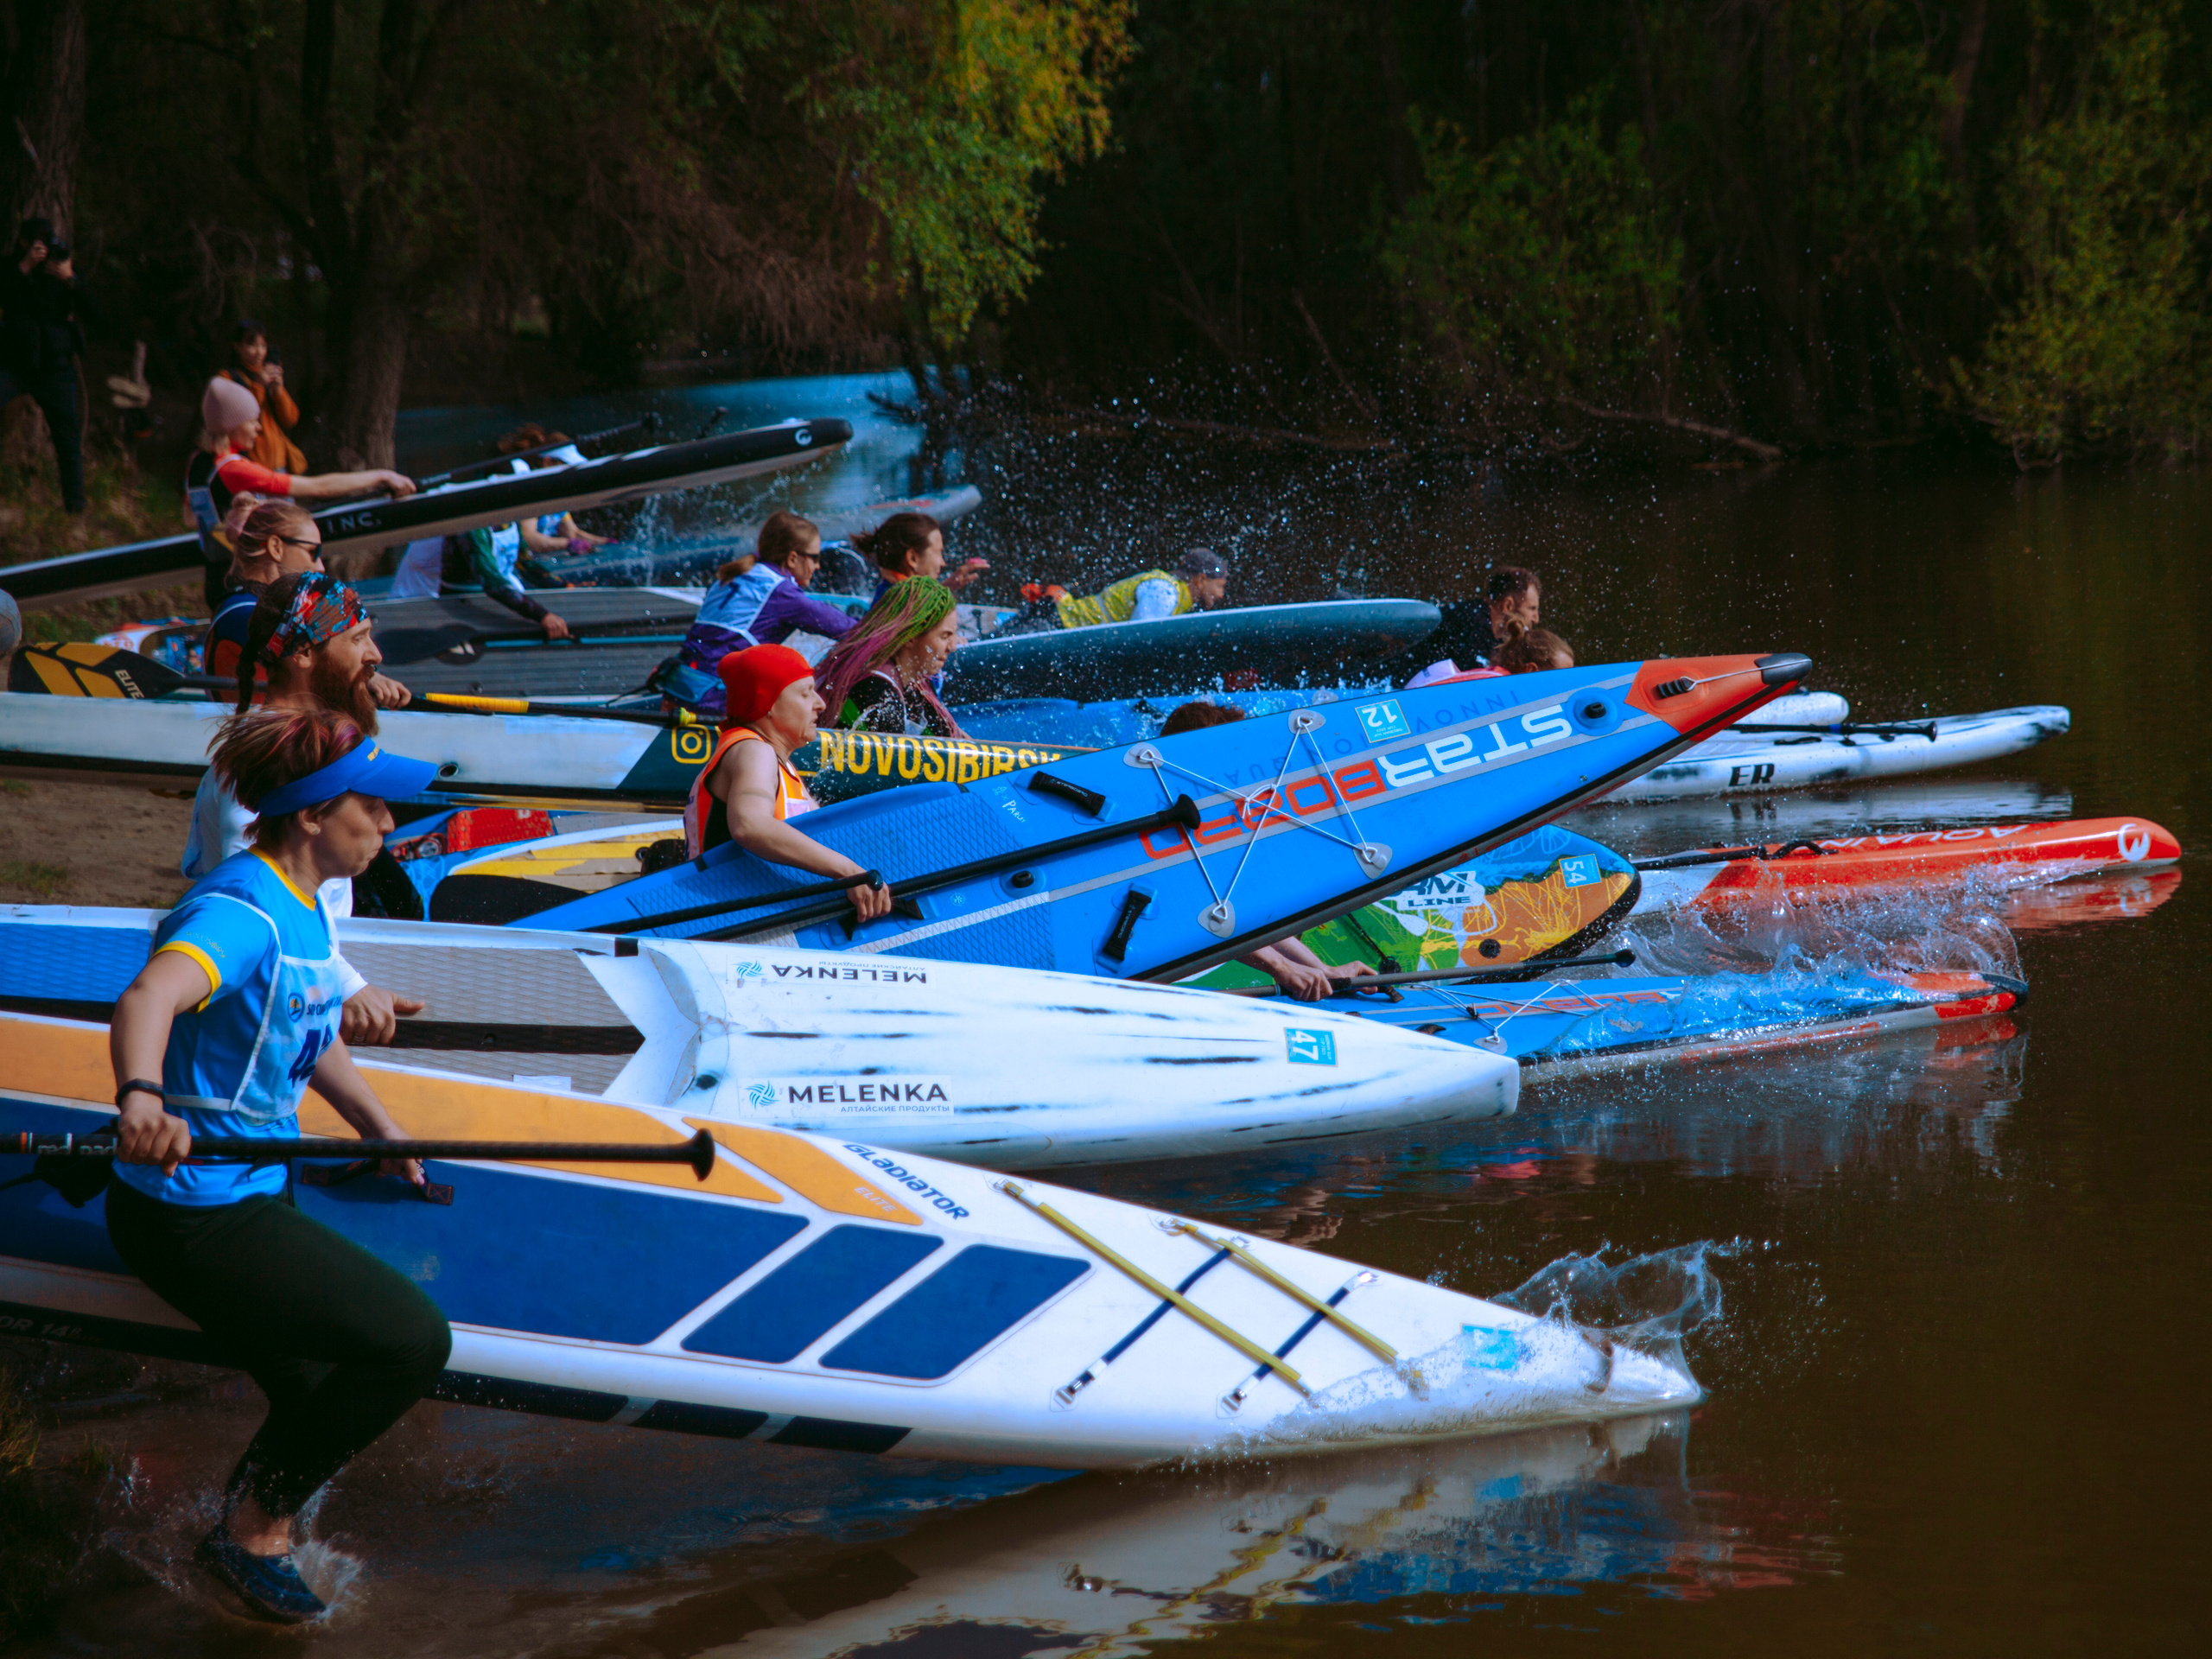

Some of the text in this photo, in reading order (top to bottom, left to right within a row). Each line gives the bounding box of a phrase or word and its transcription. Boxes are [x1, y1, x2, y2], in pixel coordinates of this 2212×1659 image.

[114, 669, 145, 699] ELITE
[1306, 690, 1519, 761] INNOVION
[1362, 704, 1397, 727] 12
[1728, 763, 1775, 787] ER
[1564, 861, 1587, 884] 54
[1408, 895, 1471, 906] LINE
[771, 964, 927, 983] MELENKA
[1291, 1030, 1319, 1060] 47
[788, 1084, 948, 1103] MELENKA
[854, 1186, 898, 1212] ELITE
